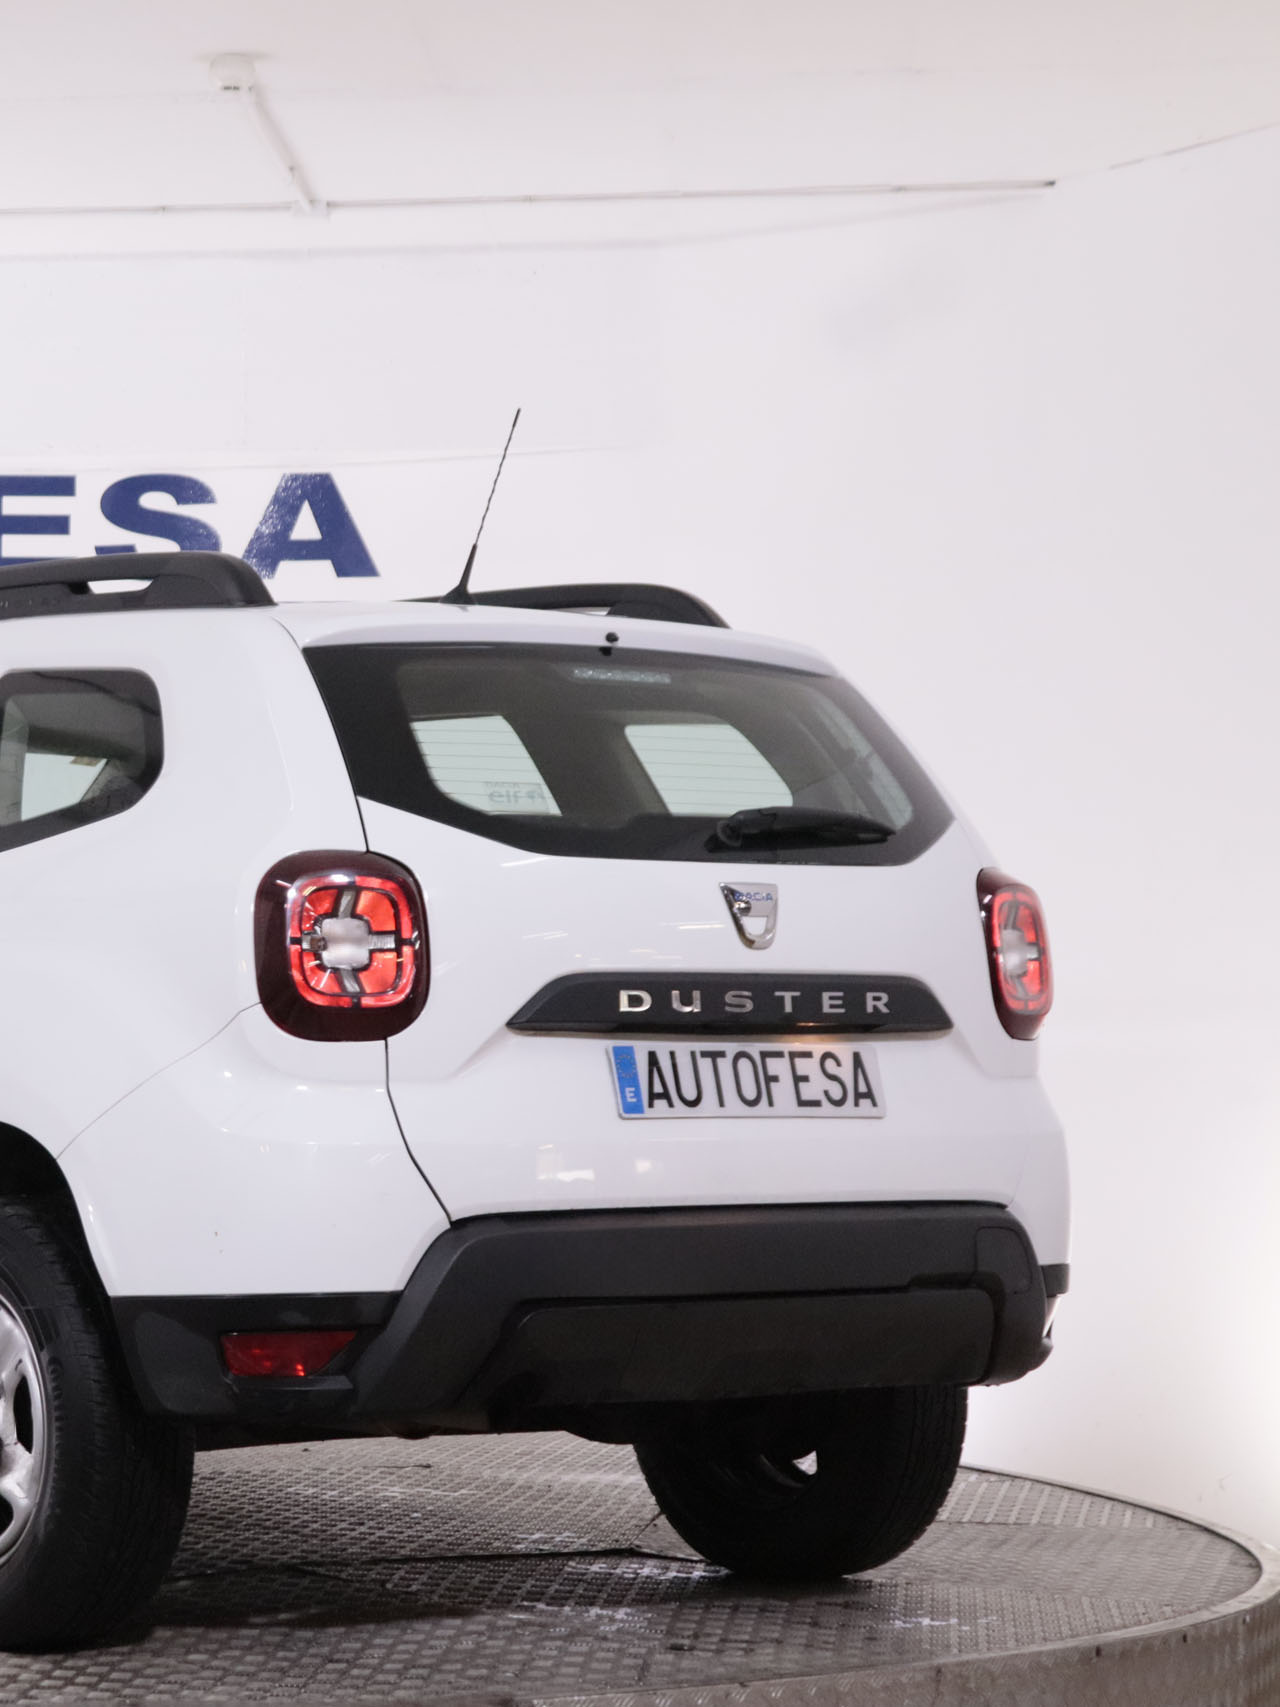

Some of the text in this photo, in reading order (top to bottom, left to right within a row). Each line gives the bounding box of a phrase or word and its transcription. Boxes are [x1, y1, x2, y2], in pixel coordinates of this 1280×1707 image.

[618, 989, 891, 1014] DUSTER
[647, 1050, 878, 1108] AUTOFESA
[625, 1087, 636, 1103] E
